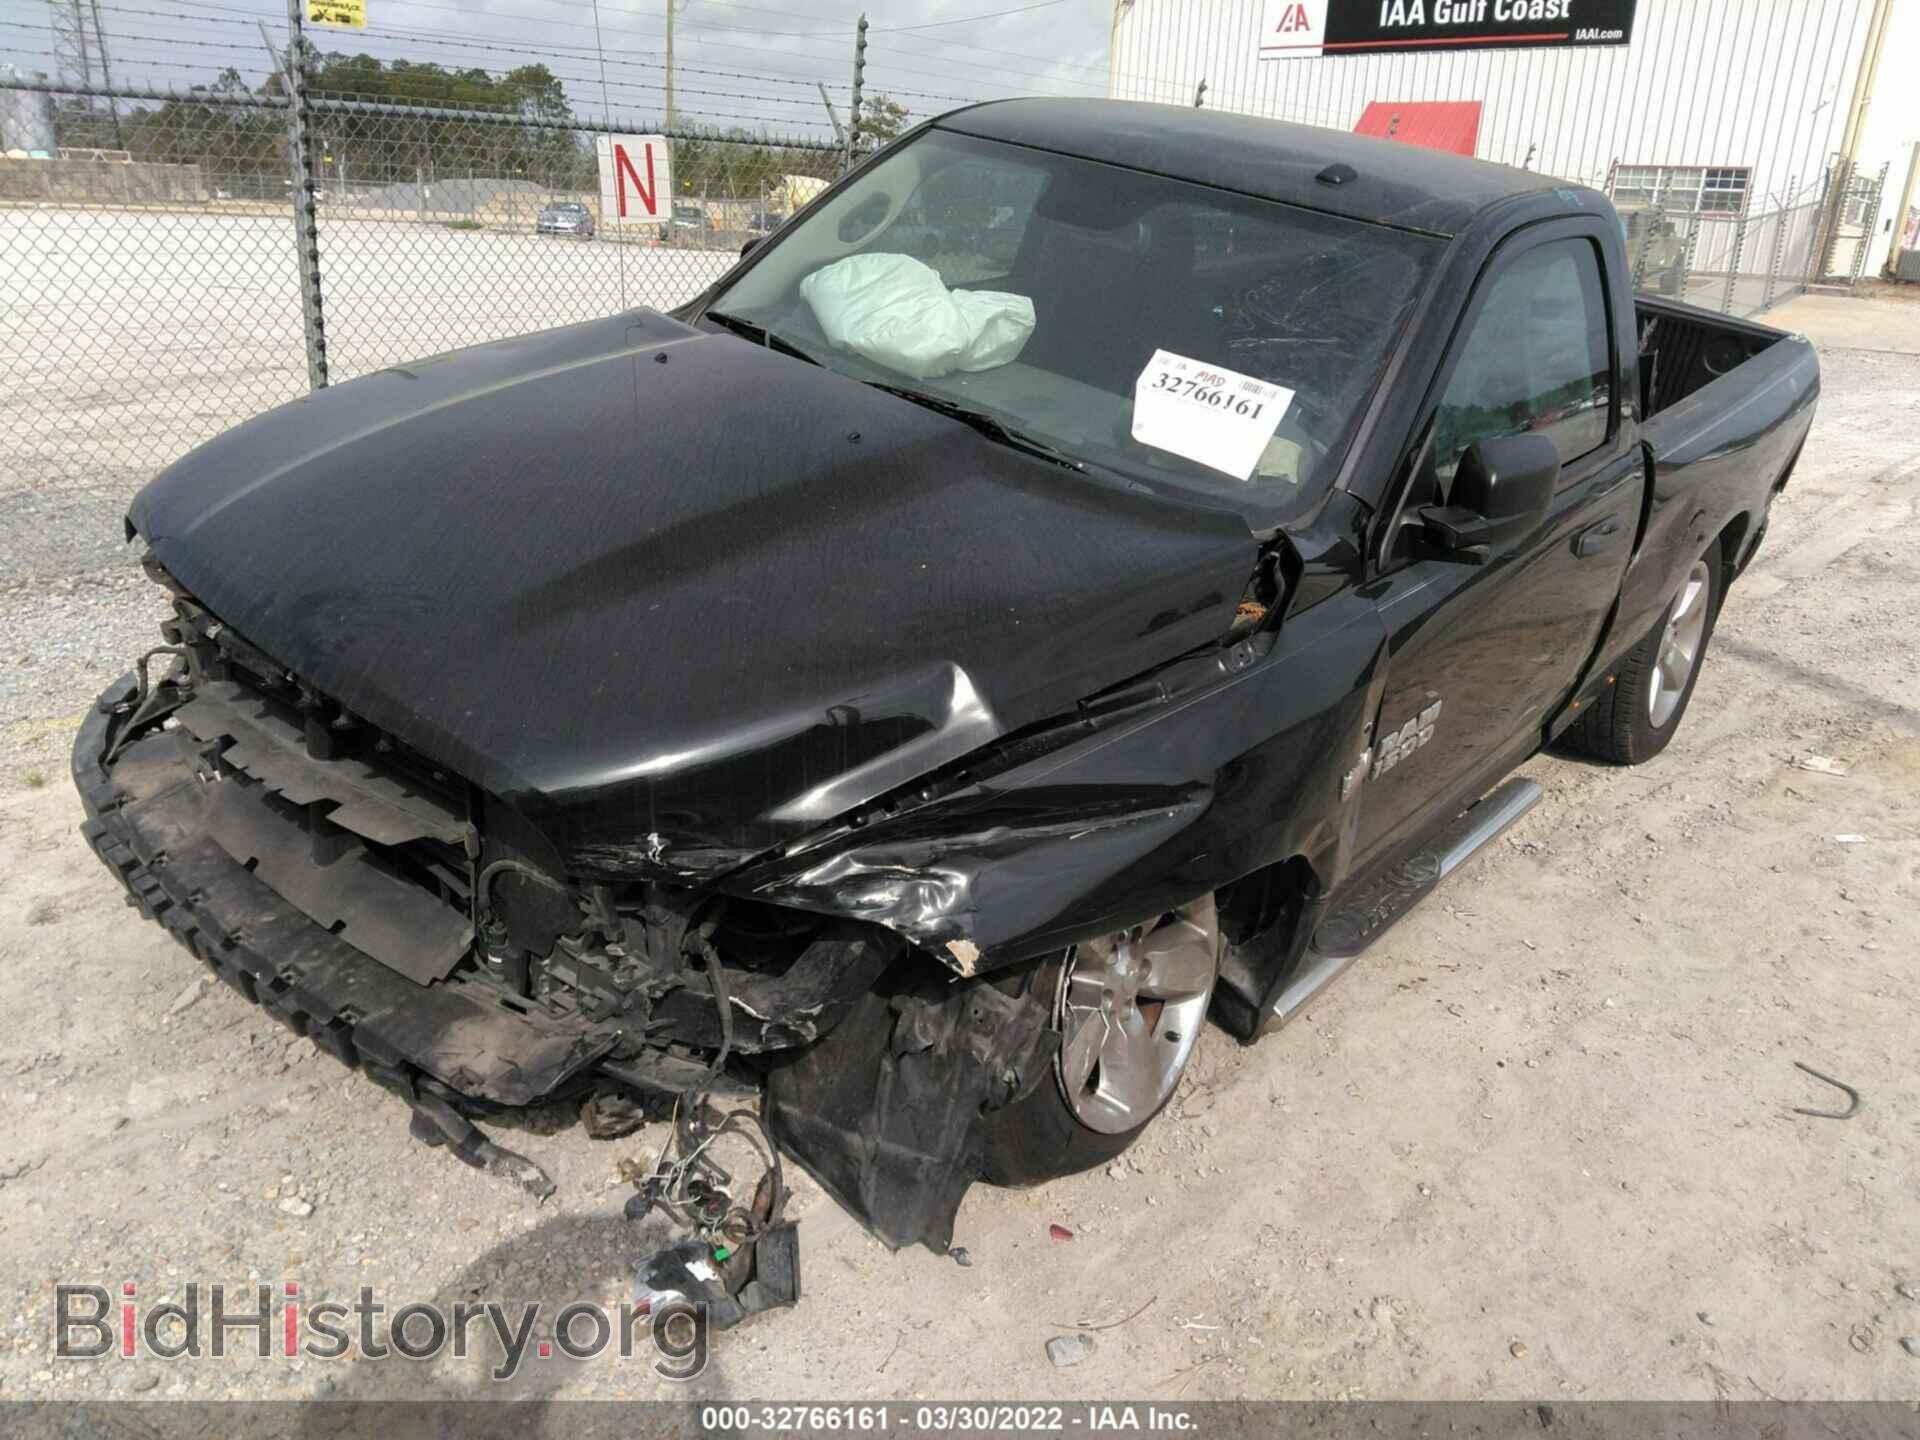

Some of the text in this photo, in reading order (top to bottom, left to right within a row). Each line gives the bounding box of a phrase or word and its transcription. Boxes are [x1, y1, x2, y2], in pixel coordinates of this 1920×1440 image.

[1380, 0, 1571, 27] IAA Gulf Coast
[614, 143, 656, 217] N
[1151, 372, 1264, 420] 32766161
